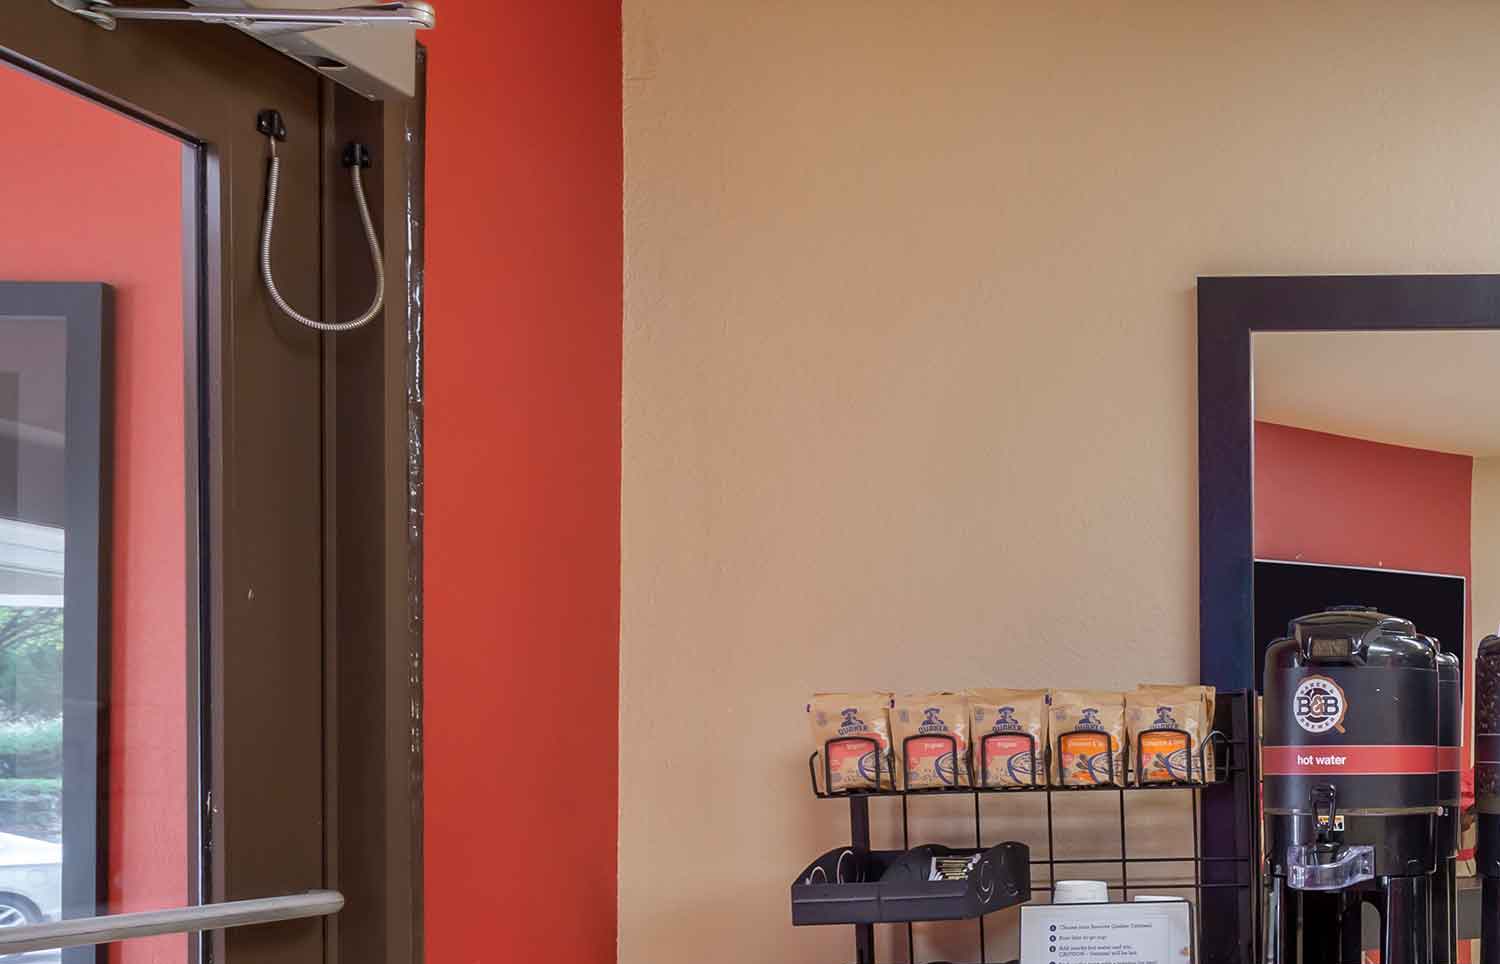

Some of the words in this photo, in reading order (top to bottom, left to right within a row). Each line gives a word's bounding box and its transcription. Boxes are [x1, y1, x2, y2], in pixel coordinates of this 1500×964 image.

[1296, 696, 1340, 716] B&B
[838, 724, 868, 736] QUAKER
[918, 724, 949, 735] QUAKER
[1297, 755, 1314, 766] hot
[1315, 756, 1347, 766] water
